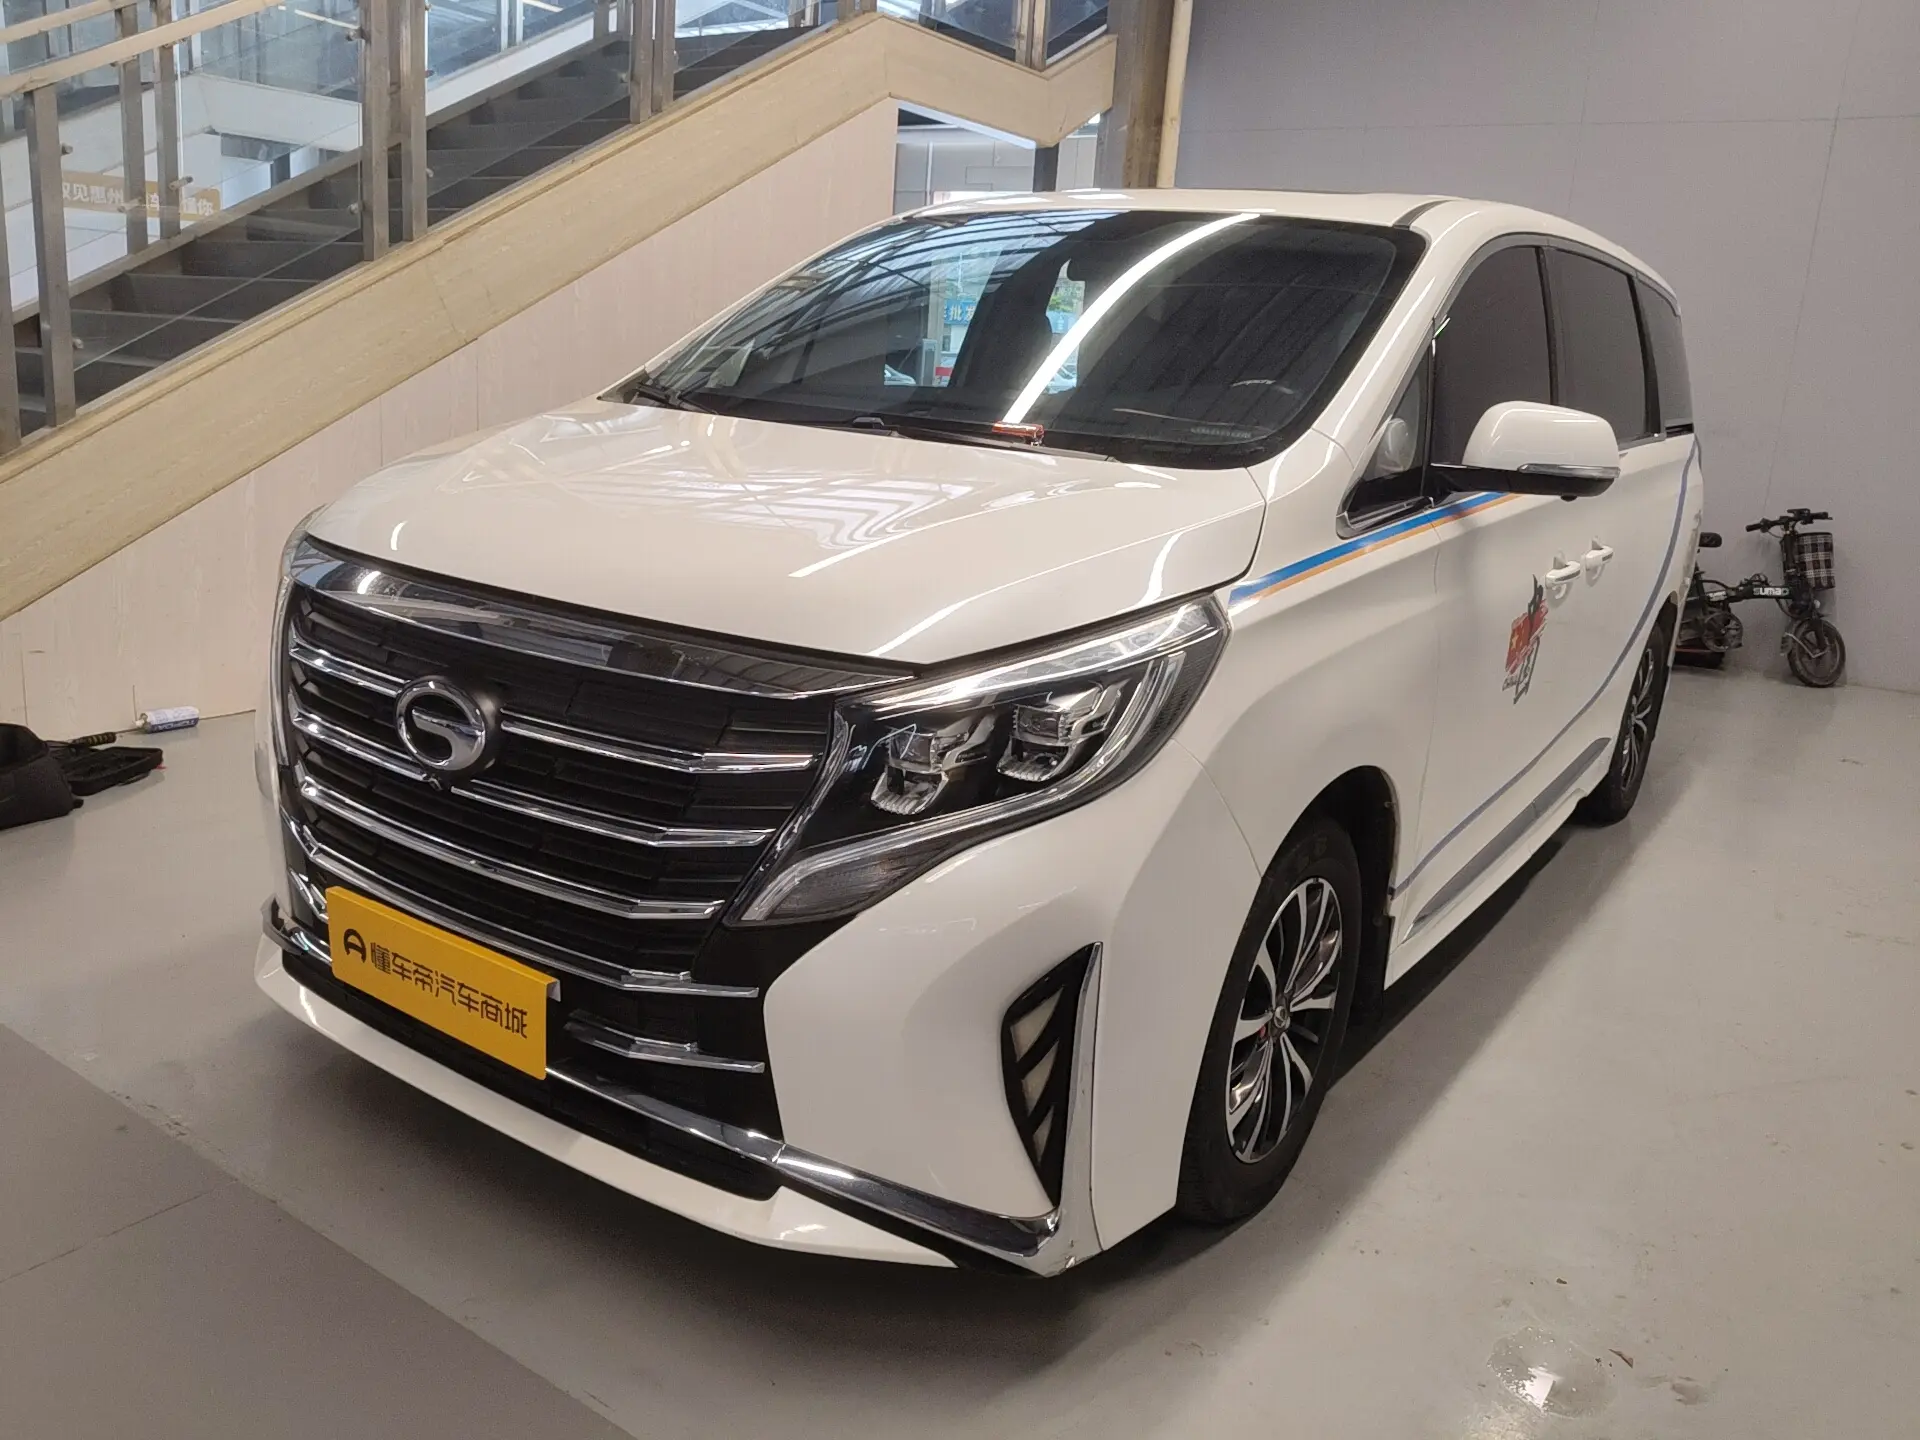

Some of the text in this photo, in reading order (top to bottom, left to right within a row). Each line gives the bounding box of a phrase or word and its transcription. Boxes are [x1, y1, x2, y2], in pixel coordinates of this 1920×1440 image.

[370, 941, 528, 1039] 懂车帝汽车商城
